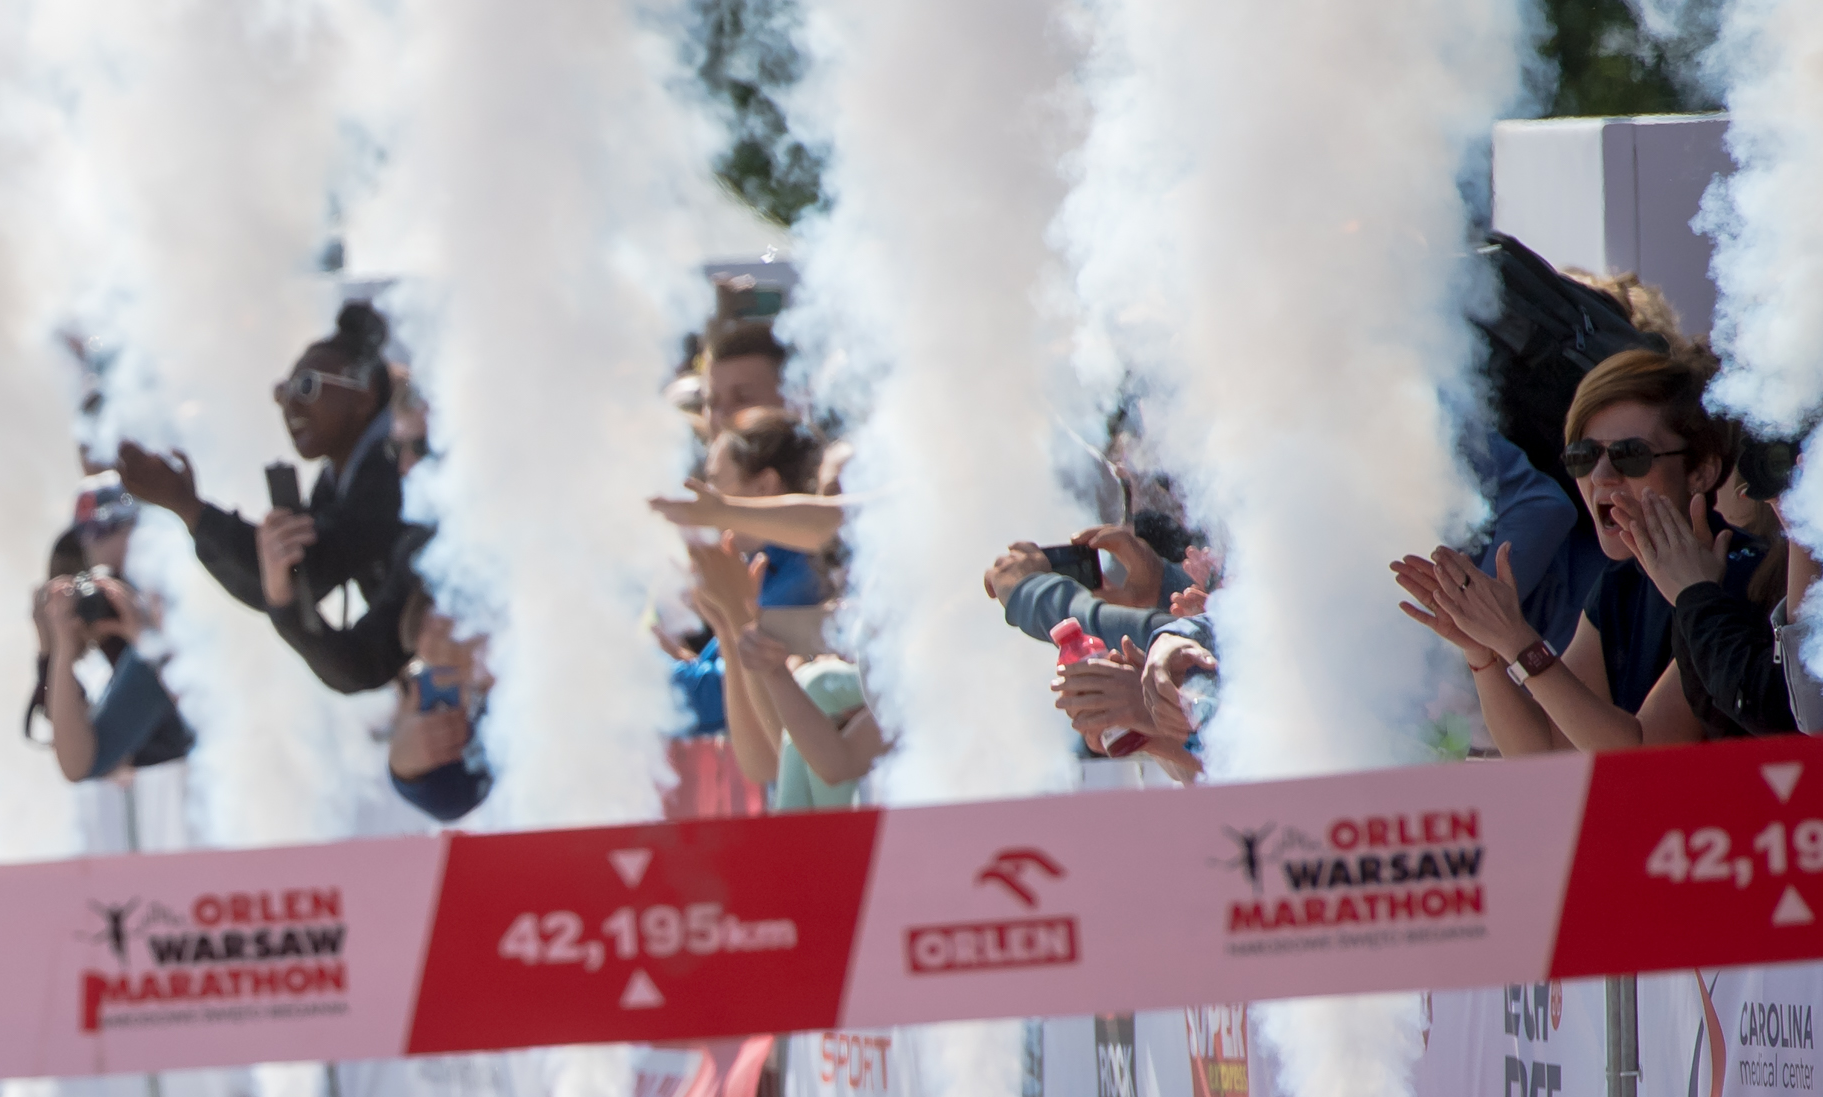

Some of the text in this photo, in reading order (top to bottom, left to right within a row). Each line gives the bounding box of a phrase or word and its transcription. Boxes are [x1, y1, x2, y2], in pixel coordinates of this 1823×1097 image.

[1329, 808, 1481, 851] ORLEN
[1284, 844, 1485, 892] WARSAW
[192, 886, 342, 927] ORLEN
[1227, 881, 1486, 934] MARATHON
[149, 923, 346, 967] WARSAW
[498, 901, 798, 973] 42,195km
[915, 927, 1069, 967] ORLEN
[84, 963, 347, 1008] MARATHON
[1186, 1002, 1246, 1059] SUPER
[1739, 1001, 1814, 1049] CAROLINA
[820, 1032, 892, 1092] SPORT
[1739, 1053, 1814, 1090] medical center
